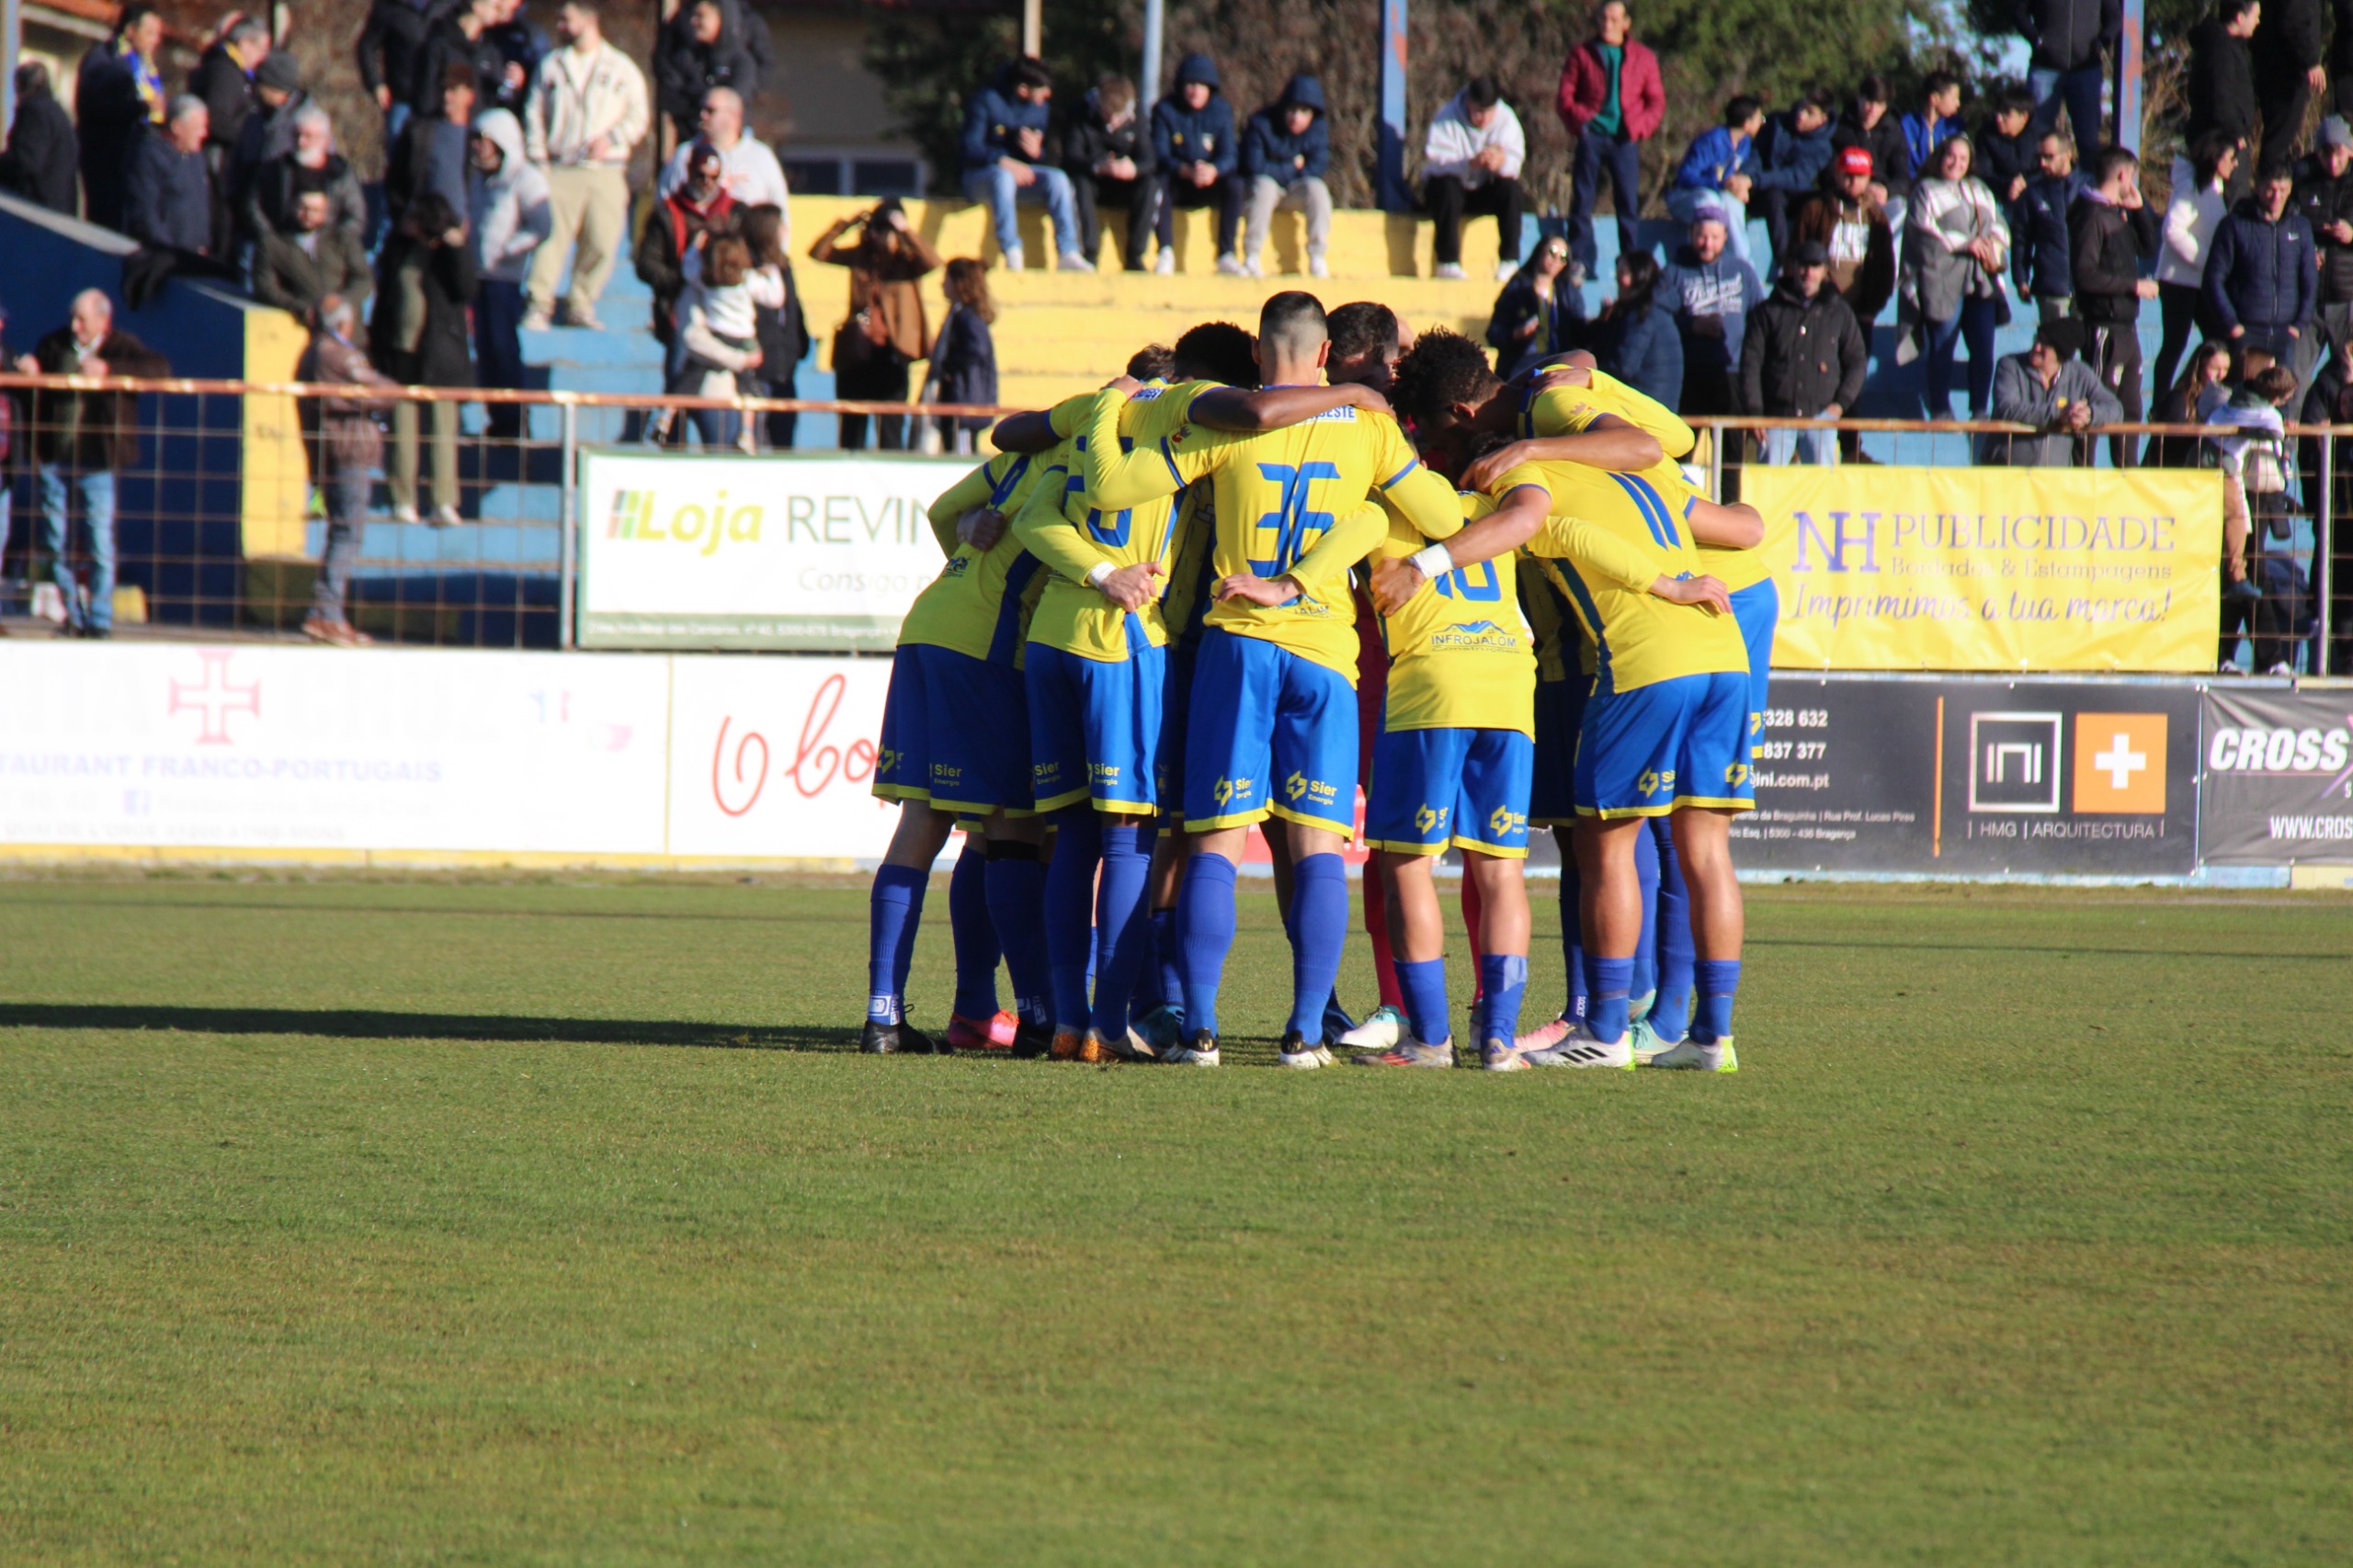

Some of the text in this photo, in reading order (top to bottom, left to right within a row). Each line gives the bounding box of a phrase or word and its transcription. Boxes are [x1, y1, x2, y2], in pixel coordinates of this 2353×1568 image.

[1605, 472, 1680, 551] 11
[635, 489, 764, 557] Loja
[1791, 511, 2175, 573] NH PUBLICIDADE
[2001, 557, 2016, 578] &
[2025, 557, 2173, 584] Estampagens
[1791, 582, 2172, 630] Imprimimos a tua marca!
[1431, 634, 1517, 647] INFROJALOM
[1798, 709, 1828, 727] 632
[1763, 742, 1827, 759] 837 377
[2209, 726, 2351, 772] CROSS
[141, 754, 443, 783] FRANCO-PORTUGAIS
[935, 764, 962, 778] Sier
[1034, 762, 1060, 776] Sier
[1095, 764, 1120, 777] Sier
[1310, 780, 1337, 797] Sier
[1980, 821, 2155, 839] HMG ARQUITECTURA
